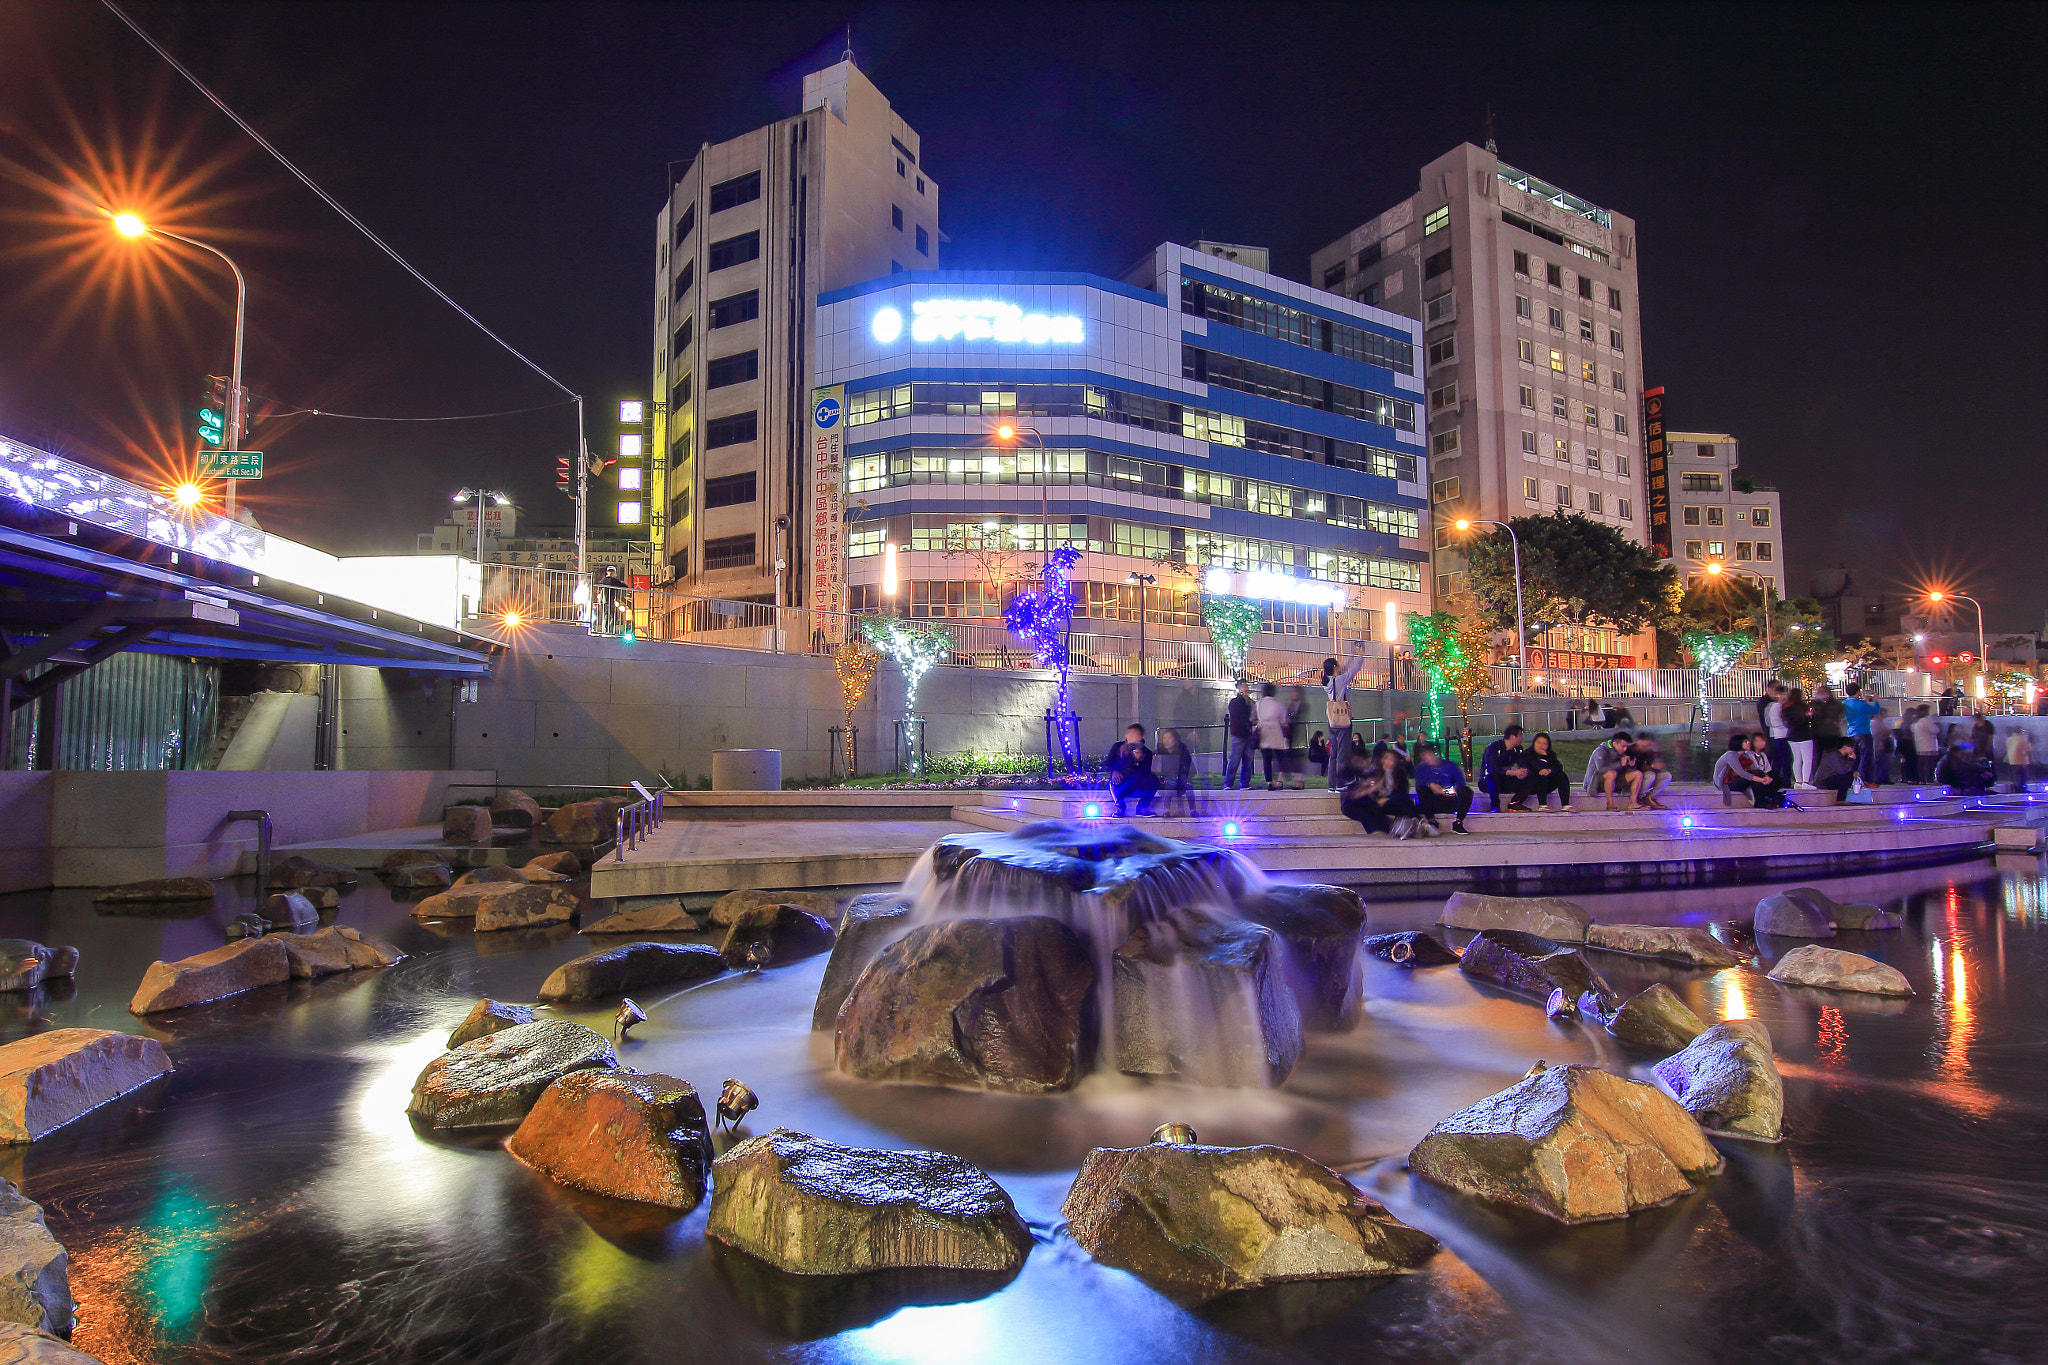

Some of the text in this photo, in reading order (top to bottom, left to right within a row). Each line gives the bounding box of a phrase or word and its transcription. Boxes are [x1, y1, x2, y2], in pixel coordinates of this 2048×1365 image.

[467, 510, 502, 521] 套出租
[467, 527, 502, 538] 中書局
[542, 553, 623, 563] TEL:22-3402
